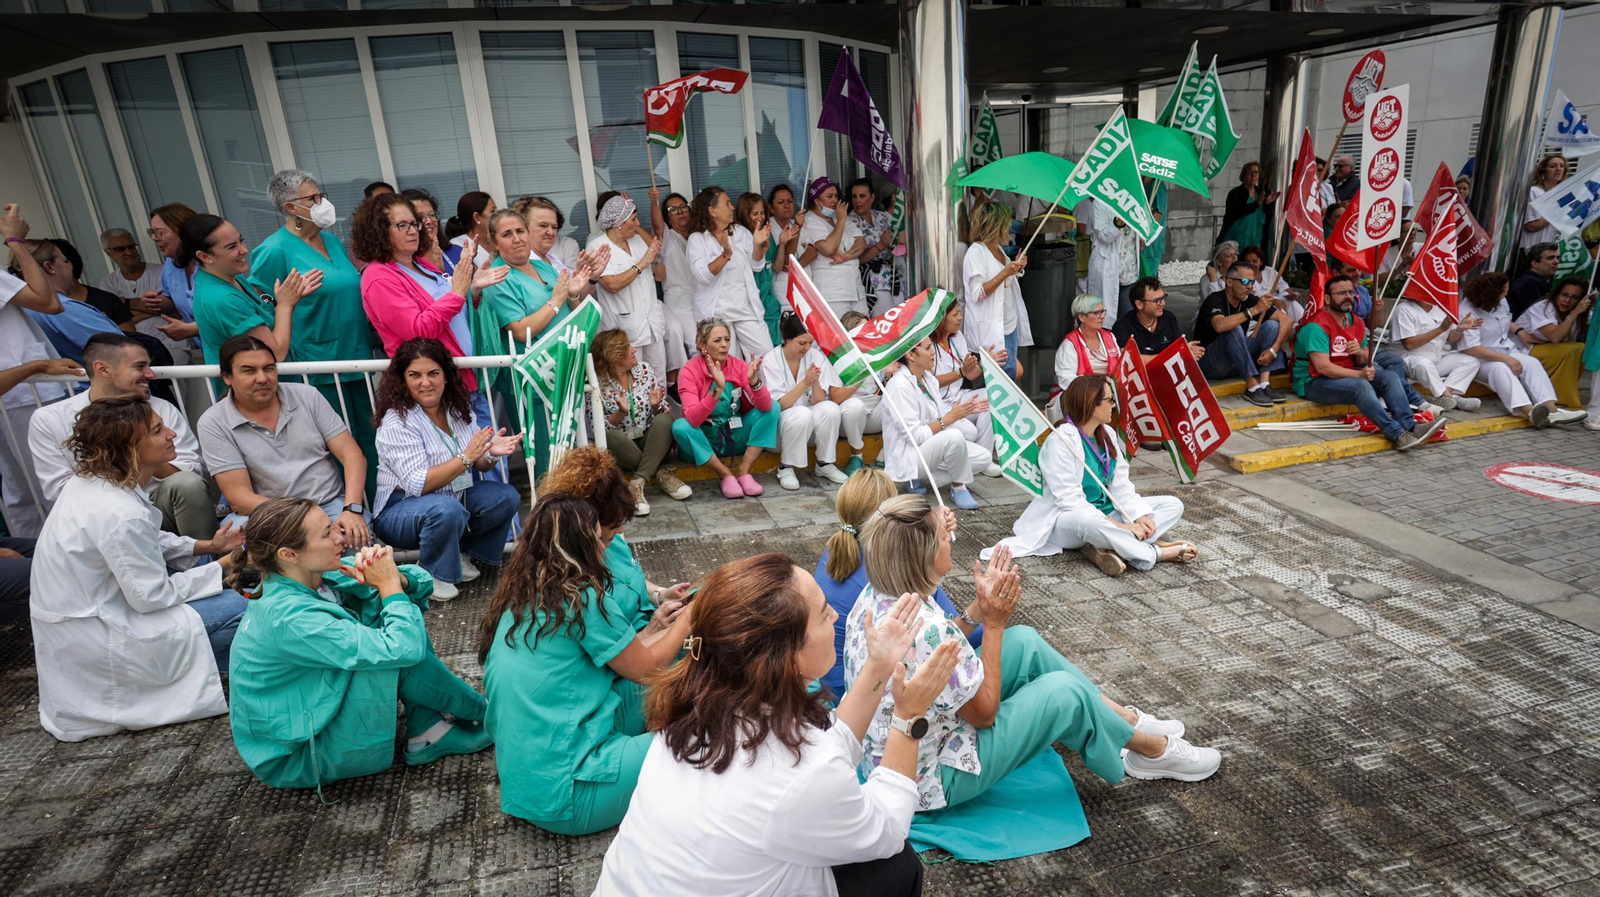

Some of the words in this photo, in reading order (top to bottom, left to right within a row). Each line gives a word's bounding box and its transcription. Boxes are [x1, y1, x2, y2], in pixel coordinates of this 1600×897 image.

[1360, 56, 1384, 81] UGT
[1377, 98, 1397, 116] UGT
[1141, 152, 1179, 170] SATSE
[1374, 150, 1394, 168] UGT
[1138, 162, 1176, 179] Cádiz
[1371, 200, 1391, 218] UGT
[1163, 351, 1221, 452] CCOO
